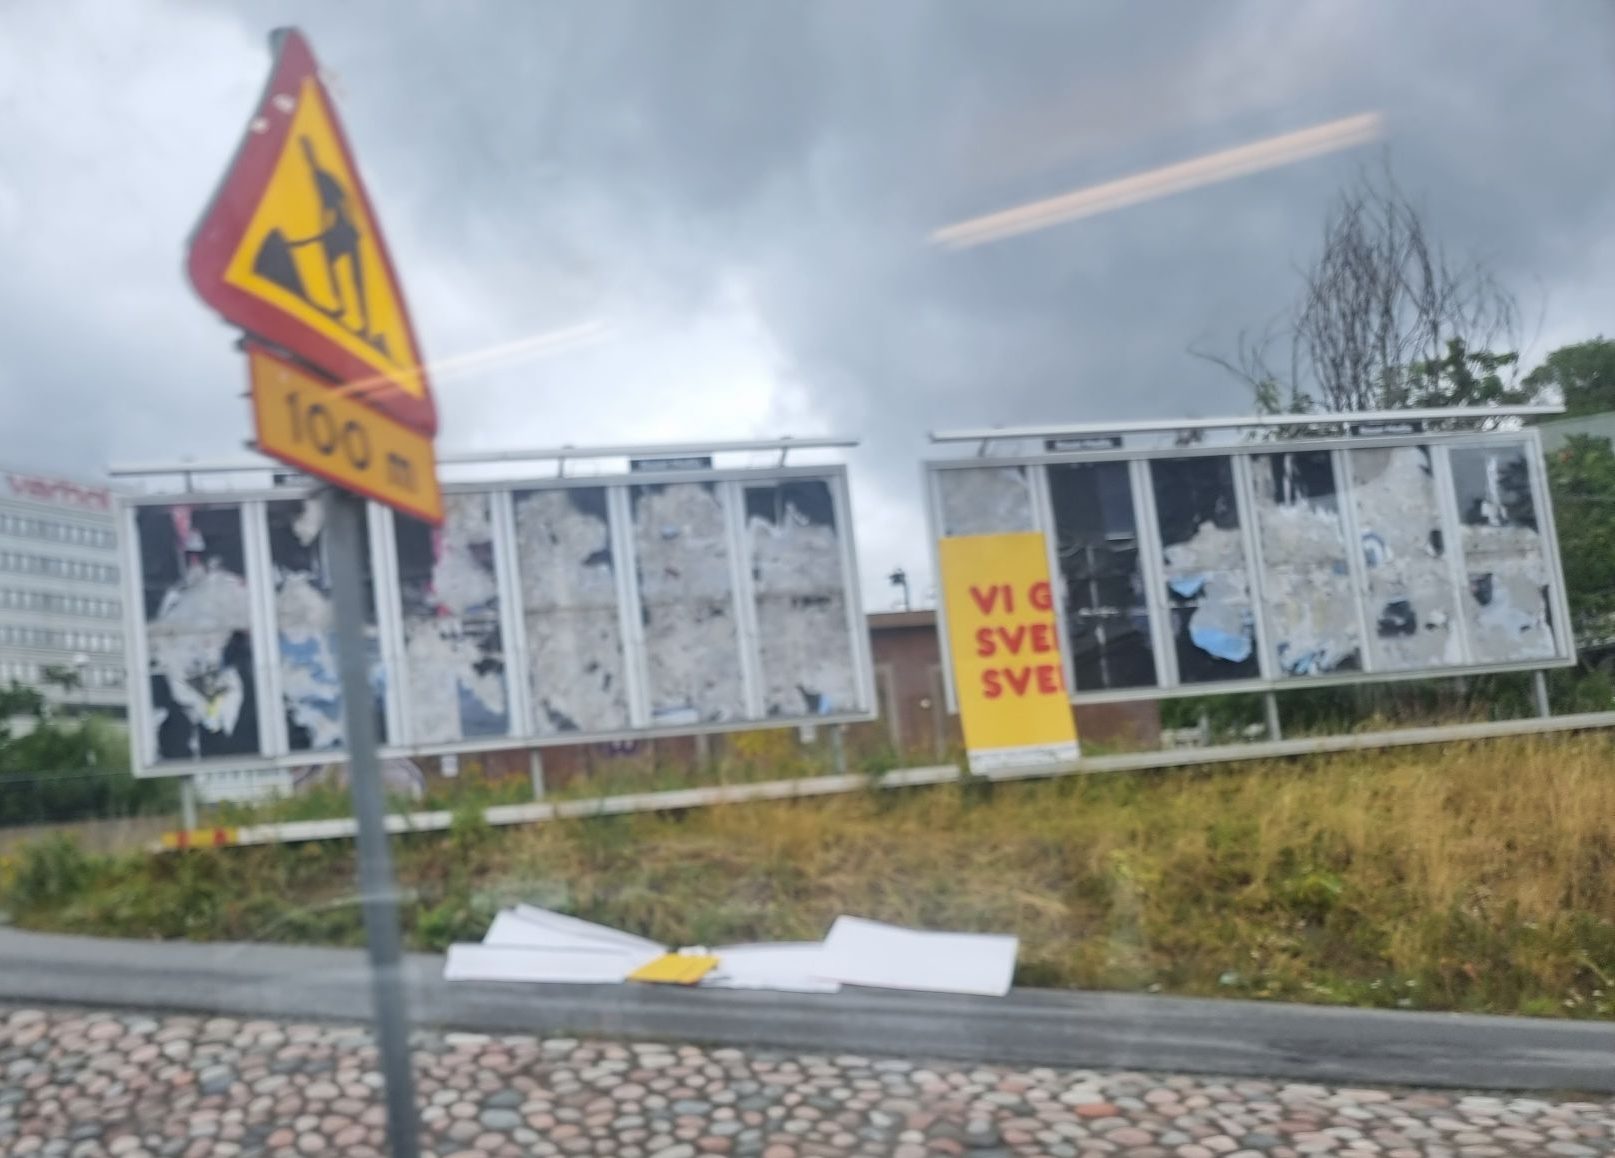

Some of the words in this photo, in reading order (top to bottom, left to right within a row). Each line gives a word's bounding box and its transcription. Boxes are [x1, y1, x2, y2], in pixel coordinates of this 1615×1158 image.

[286, 392, 373, 472] 100
[386, 451, 420, 495] m
[969, 584, 1015, 615] VI
[975, 623, 1058, 658] SVE
[981, 665, 1065, 699] SVE
